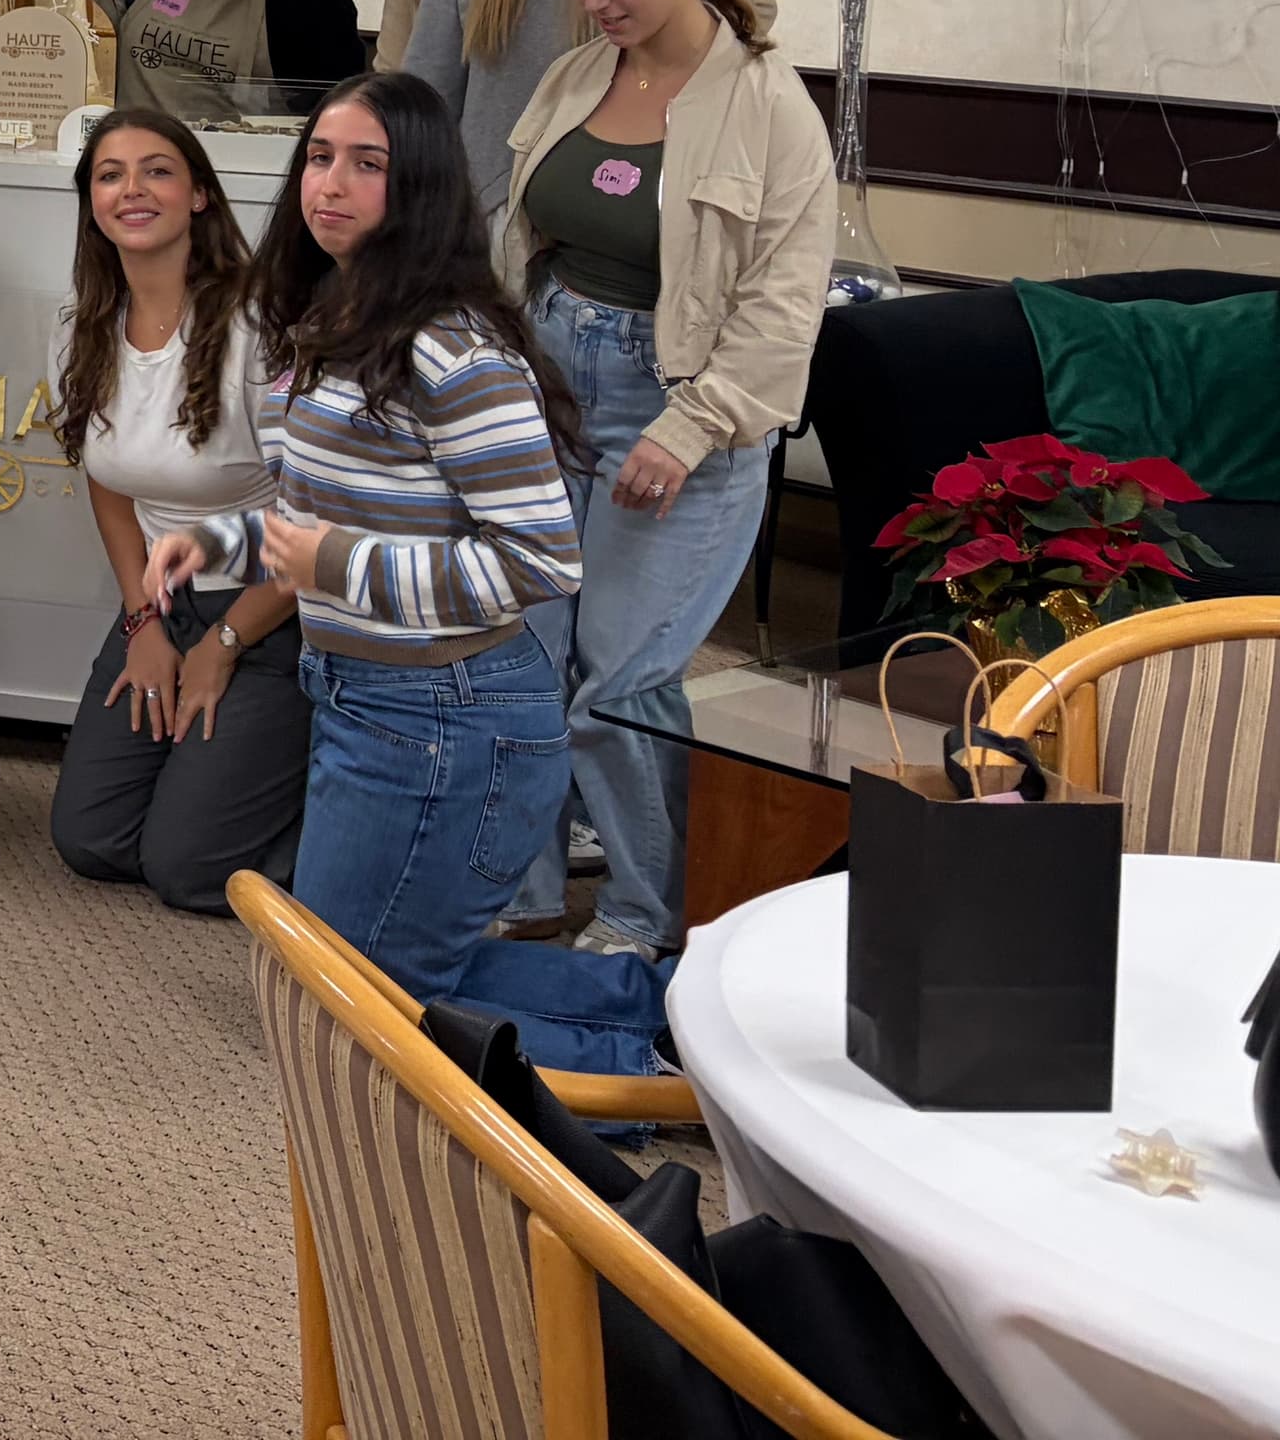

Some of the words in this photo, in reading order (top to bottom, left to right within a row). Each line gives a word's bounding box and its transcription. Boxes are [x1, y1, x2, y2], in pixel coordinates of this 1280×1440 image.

[6, 32, 62, 48] HAUTE
[140, 23, 230, 68] HAUTE
[598, 168, 623, 185] Simi
